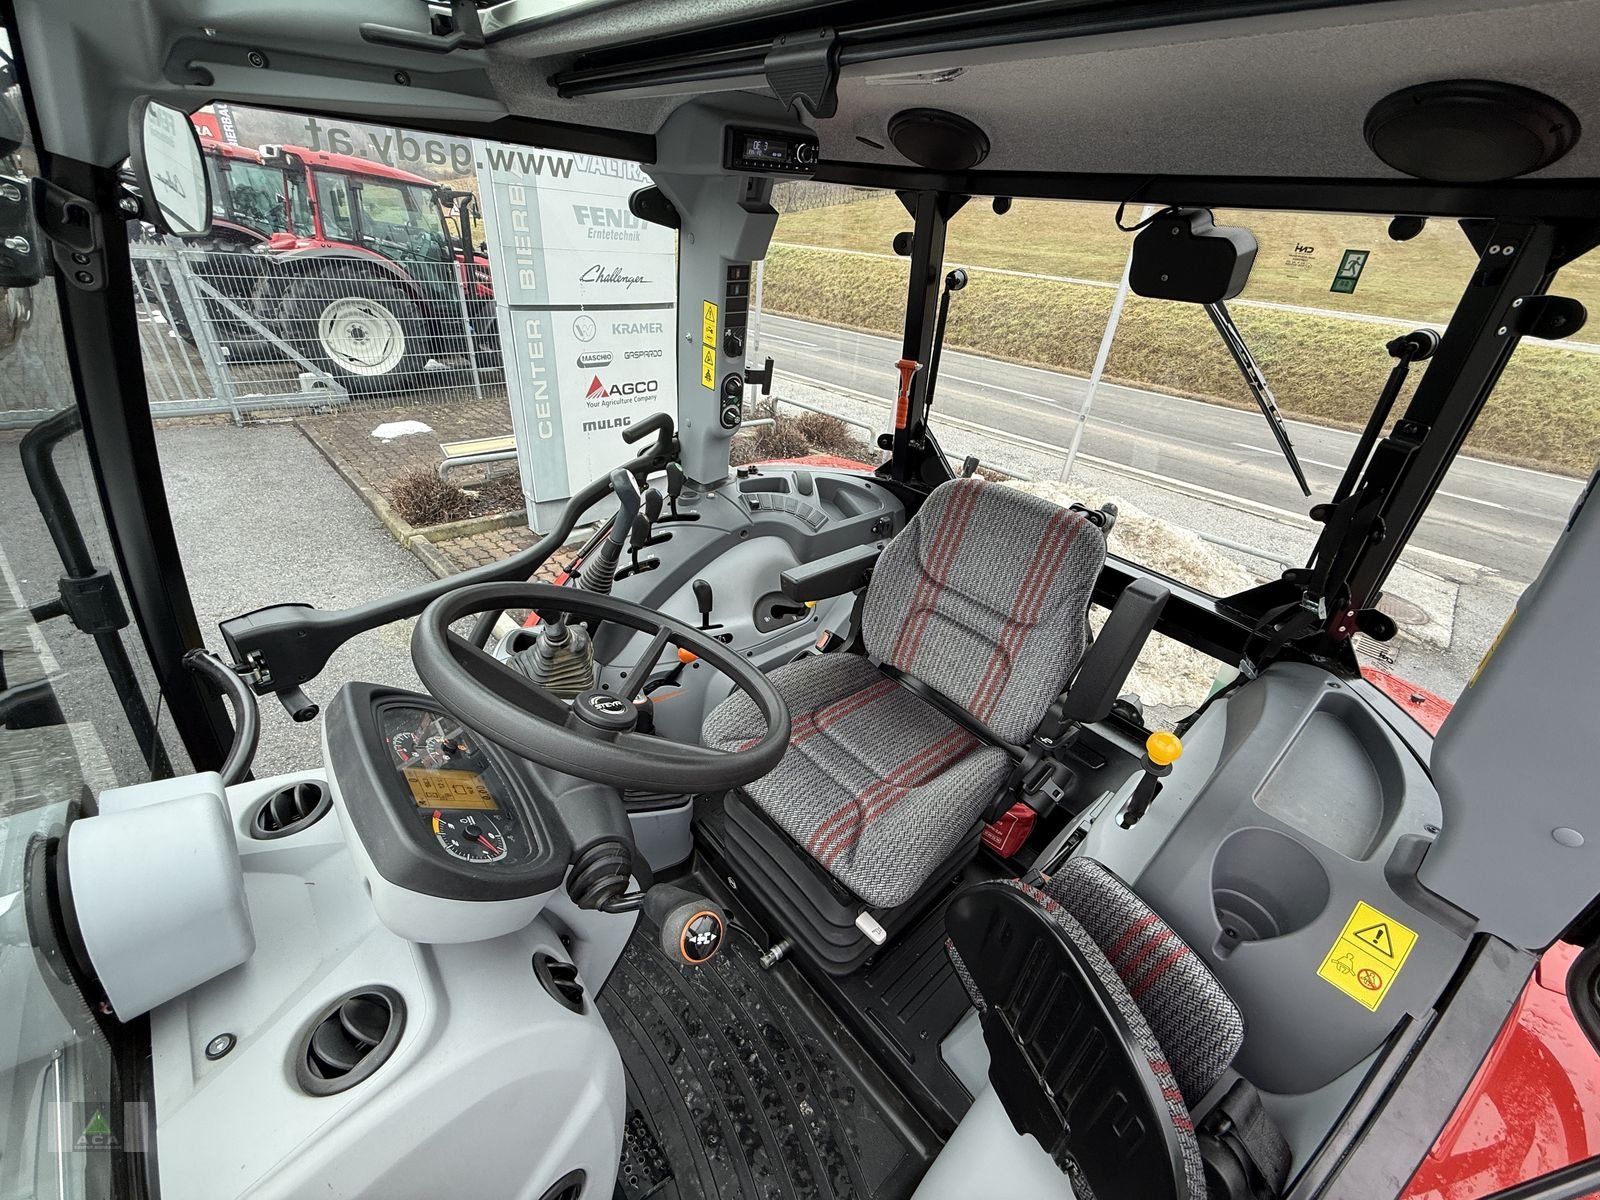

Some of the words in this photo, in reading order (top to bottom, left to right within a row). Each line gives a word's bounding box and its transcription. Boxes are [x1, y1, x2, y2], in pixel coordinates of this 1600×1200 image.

[508, 145, 536, 290] BIERBA
[587, 227, 641, 242] Erntetechnik
[579, 264, 653, 290] Challenger
[612, 322, 663, 335] KRAMER
[581, 353, 612, 362] MASCHIO
[624, 349, 663, 360] GASPARDO
[525, 318, 553, 440] CENTER
[609, 379, 658, 396] AGCO
[586, 400, 600, 409] Your
[601, 398, 633, 409] Agriculture
[634, 394, 657, 404] Company
